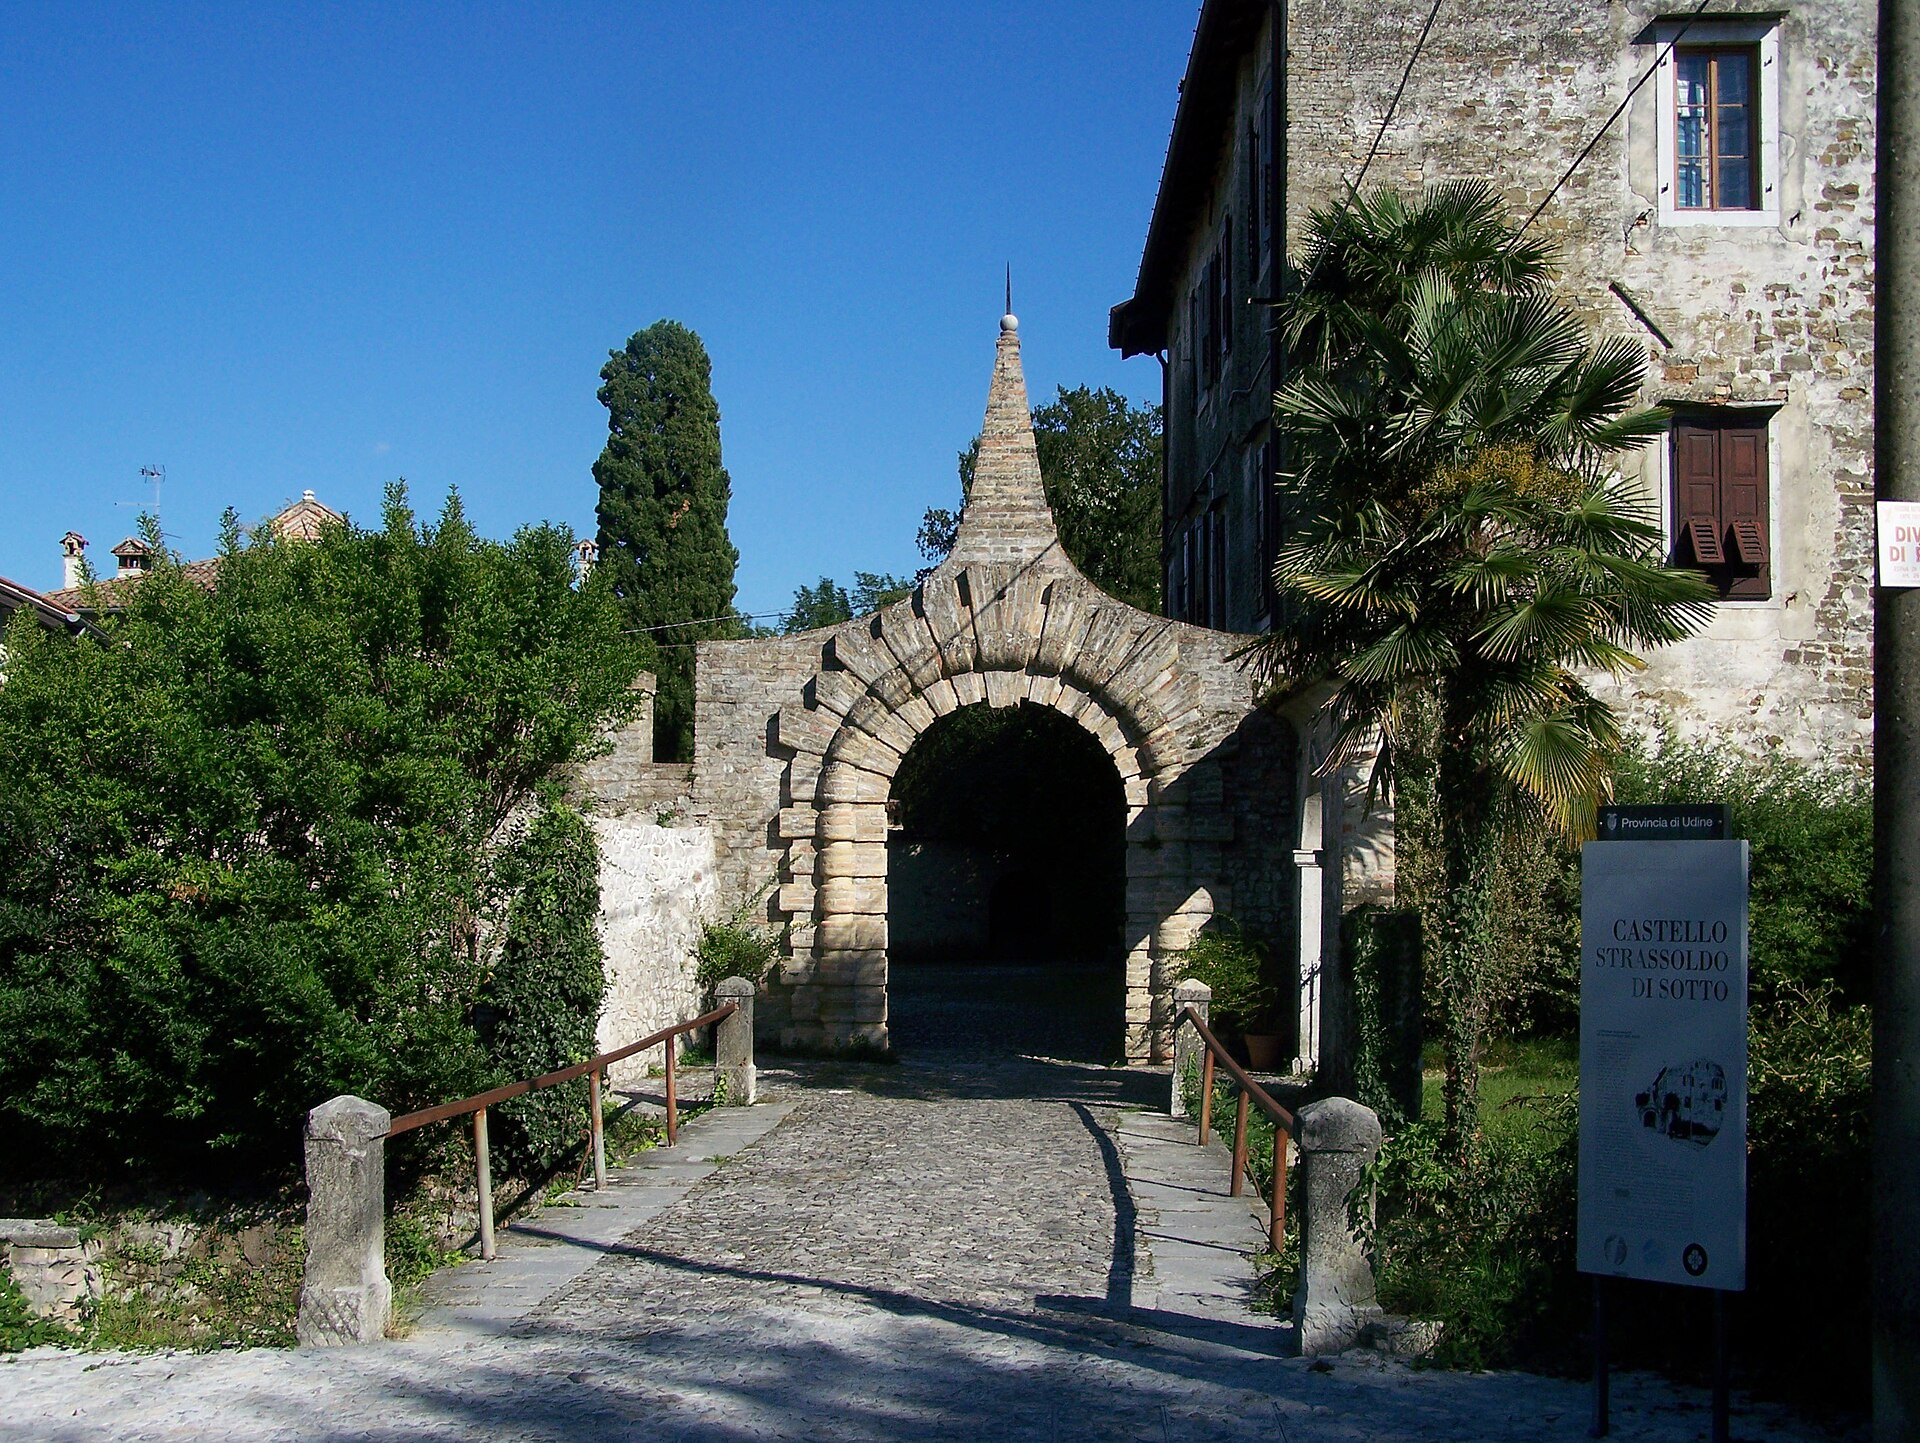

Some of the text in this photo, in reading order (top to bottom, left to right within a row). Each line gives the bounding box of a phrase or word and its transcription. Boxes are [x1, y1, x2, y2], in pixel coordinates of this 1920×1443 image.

[1890, 546, 1905, 562] DI
[1621, 817, 1713, 828] Provincia di Udine
[1613, 919, 1728, 943] CASTELLO
[1595, 947, 1729, 972] STRASSOLDO
[1632, 977, 1728, 1001] DI SOTTO
